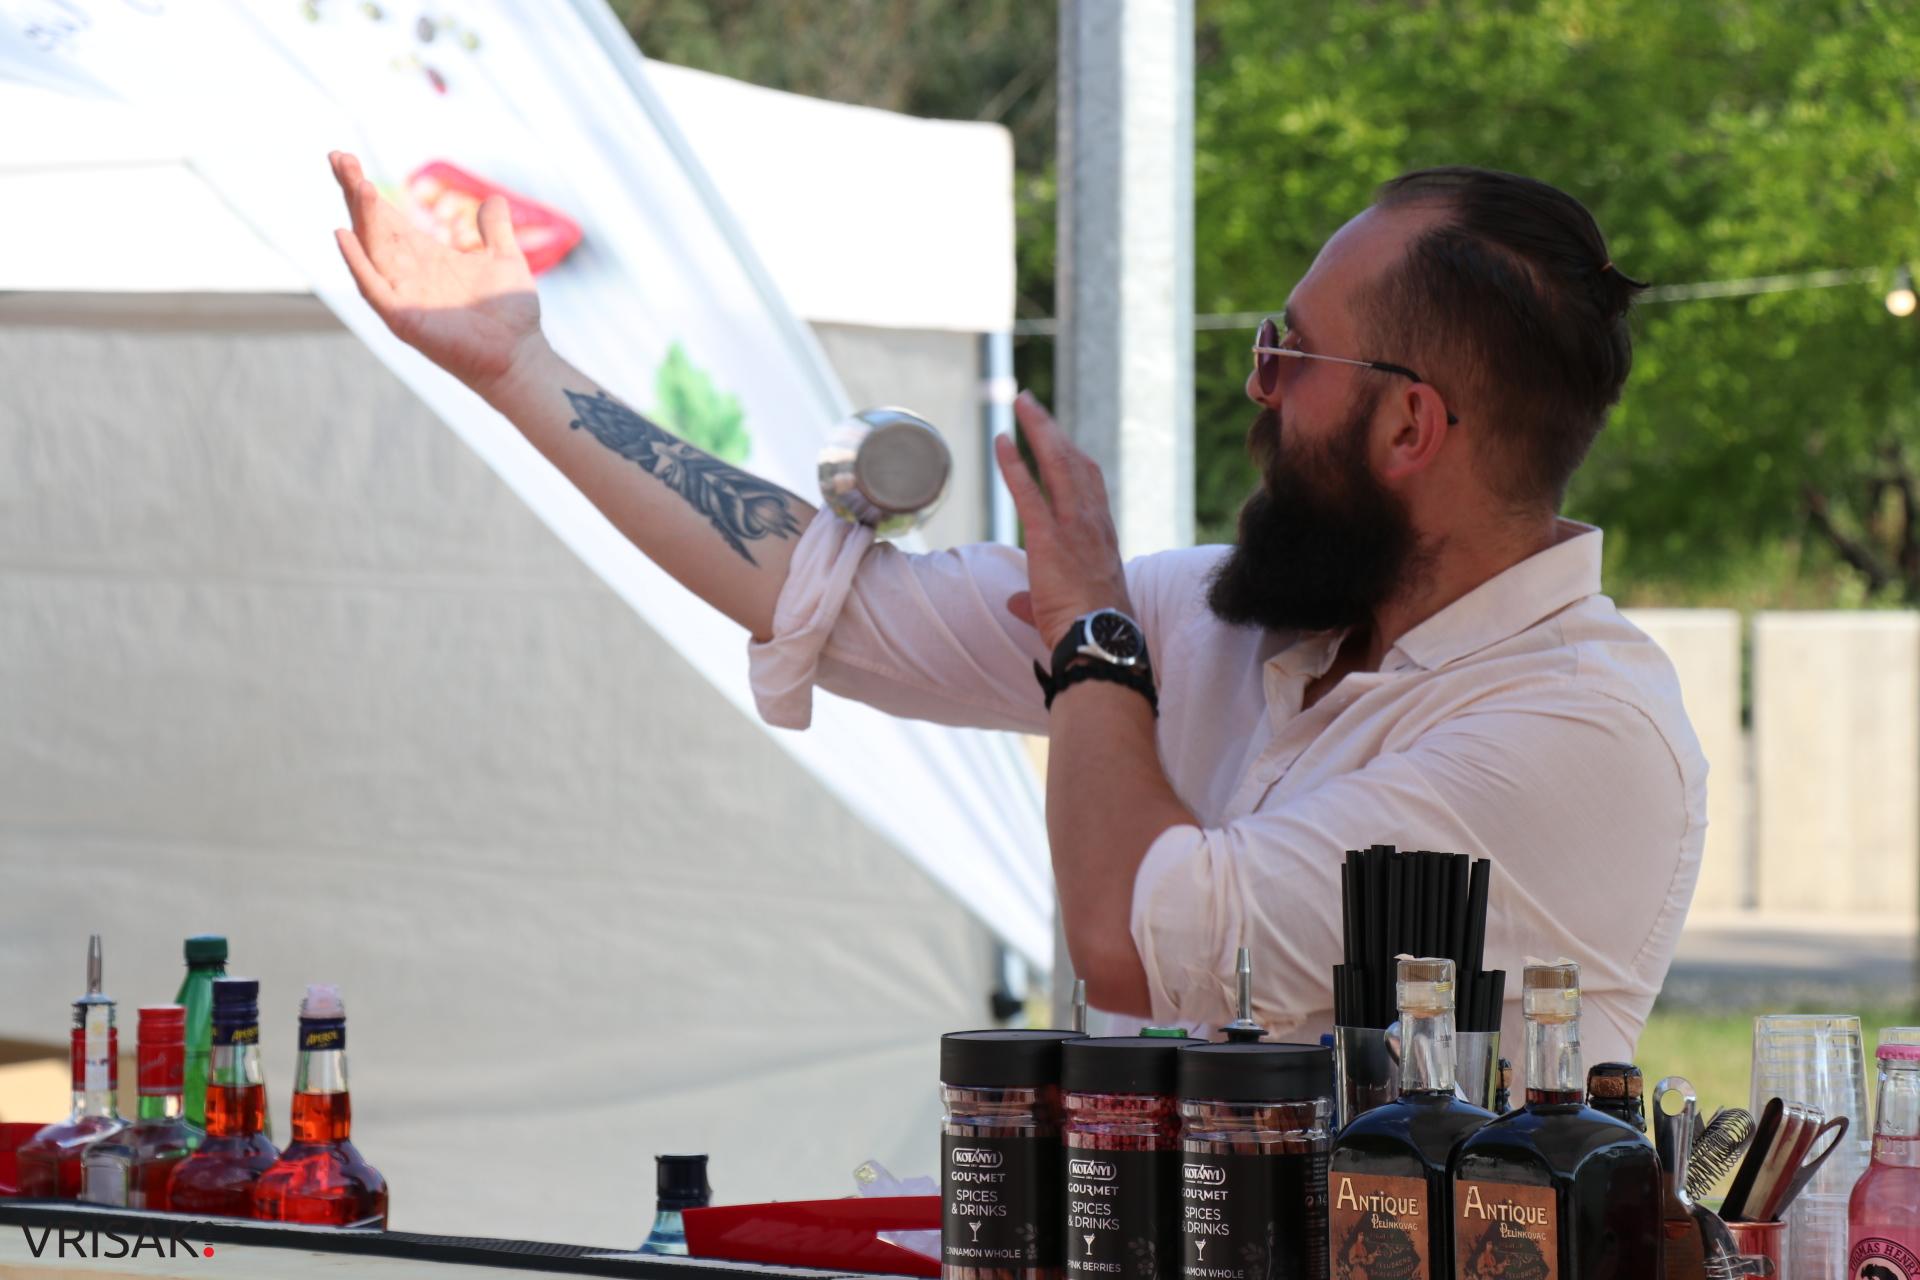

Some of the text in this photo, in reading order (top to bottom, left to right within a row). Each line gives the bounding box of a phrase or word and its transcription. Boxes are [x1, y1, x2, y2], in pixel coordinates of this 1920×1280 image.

[951, 1171, 1007, 1184] GOURMET
[956, 1189, 998, 1202] SPICES
[1068, 1182, 1120, 1196] GOURMET
[1182, 1187, 1229, 1201] GOURMET
[951, 1202, 1007, 1217] & DRINKS
[1072, 1201, 1112, 1216] SPICES
[1185, 1206, 1221, 1221] SPICES
[1068, 1214, 1120, 1231] & DRINKS
[1187, 1221, 1230, 1236] DRINKS
[984, 1248, 1021, 1259] WHOLE
[1884, 1244, 1920, 1276] HENRY
[1082, 1261, 1121, 1273] BERRIES
[1208, 1268, 1245, 1279] WHOLE
